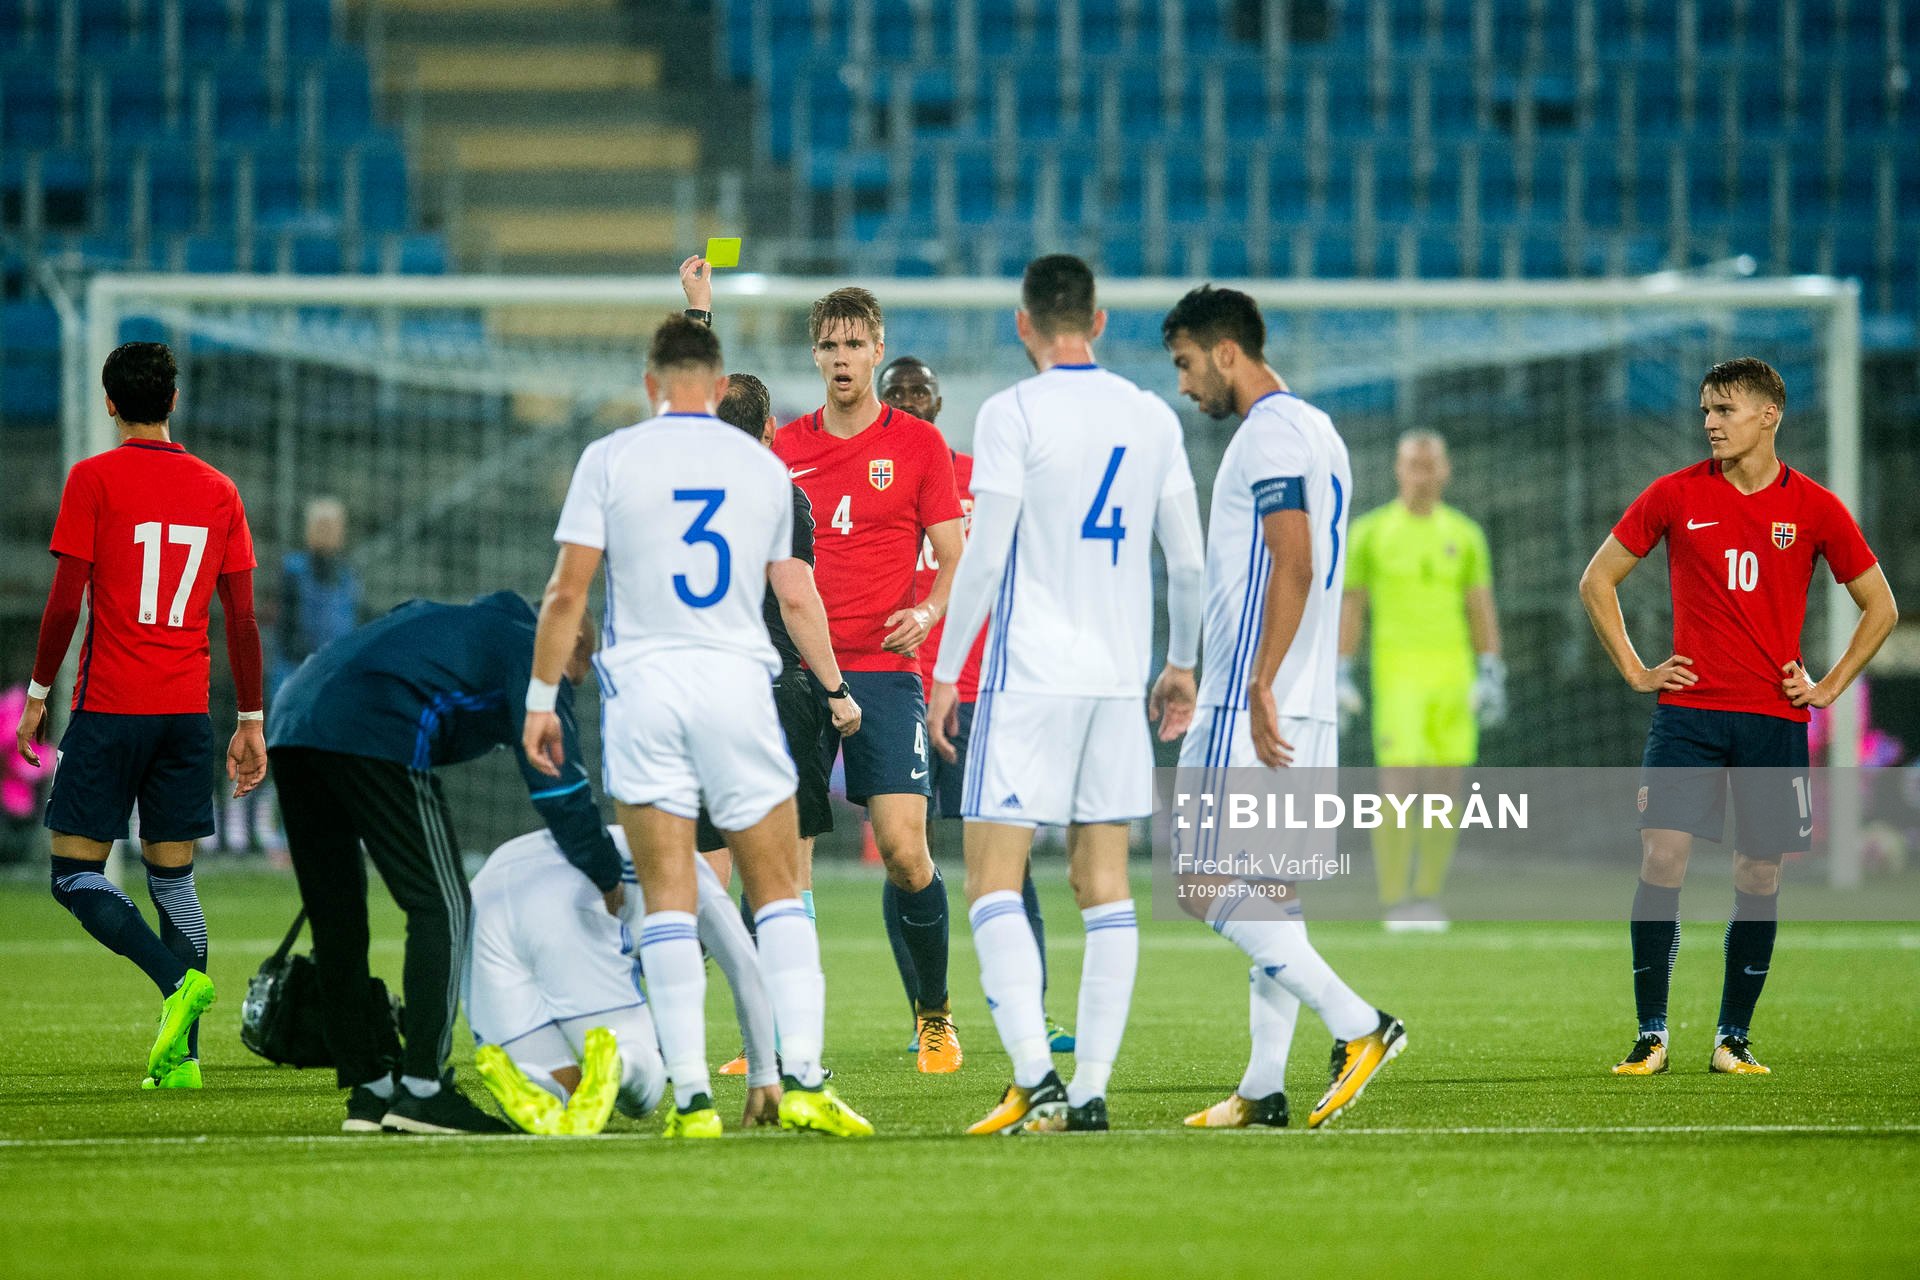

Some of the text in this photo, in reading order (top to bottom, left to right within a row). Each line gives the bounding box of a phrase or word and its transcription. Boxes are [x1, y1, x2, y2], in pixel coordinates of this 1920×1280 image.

[831, 495, 853, 535] 4
[1080, 446, 1127, 565] 4
[673, 488, 731, 608] 3
[133, 521, 209, 627] 17
[1724, 549, 1759, 592] 10
[913, 721, 926, 763] 4
[1792, 776, 1812, 818] 1
